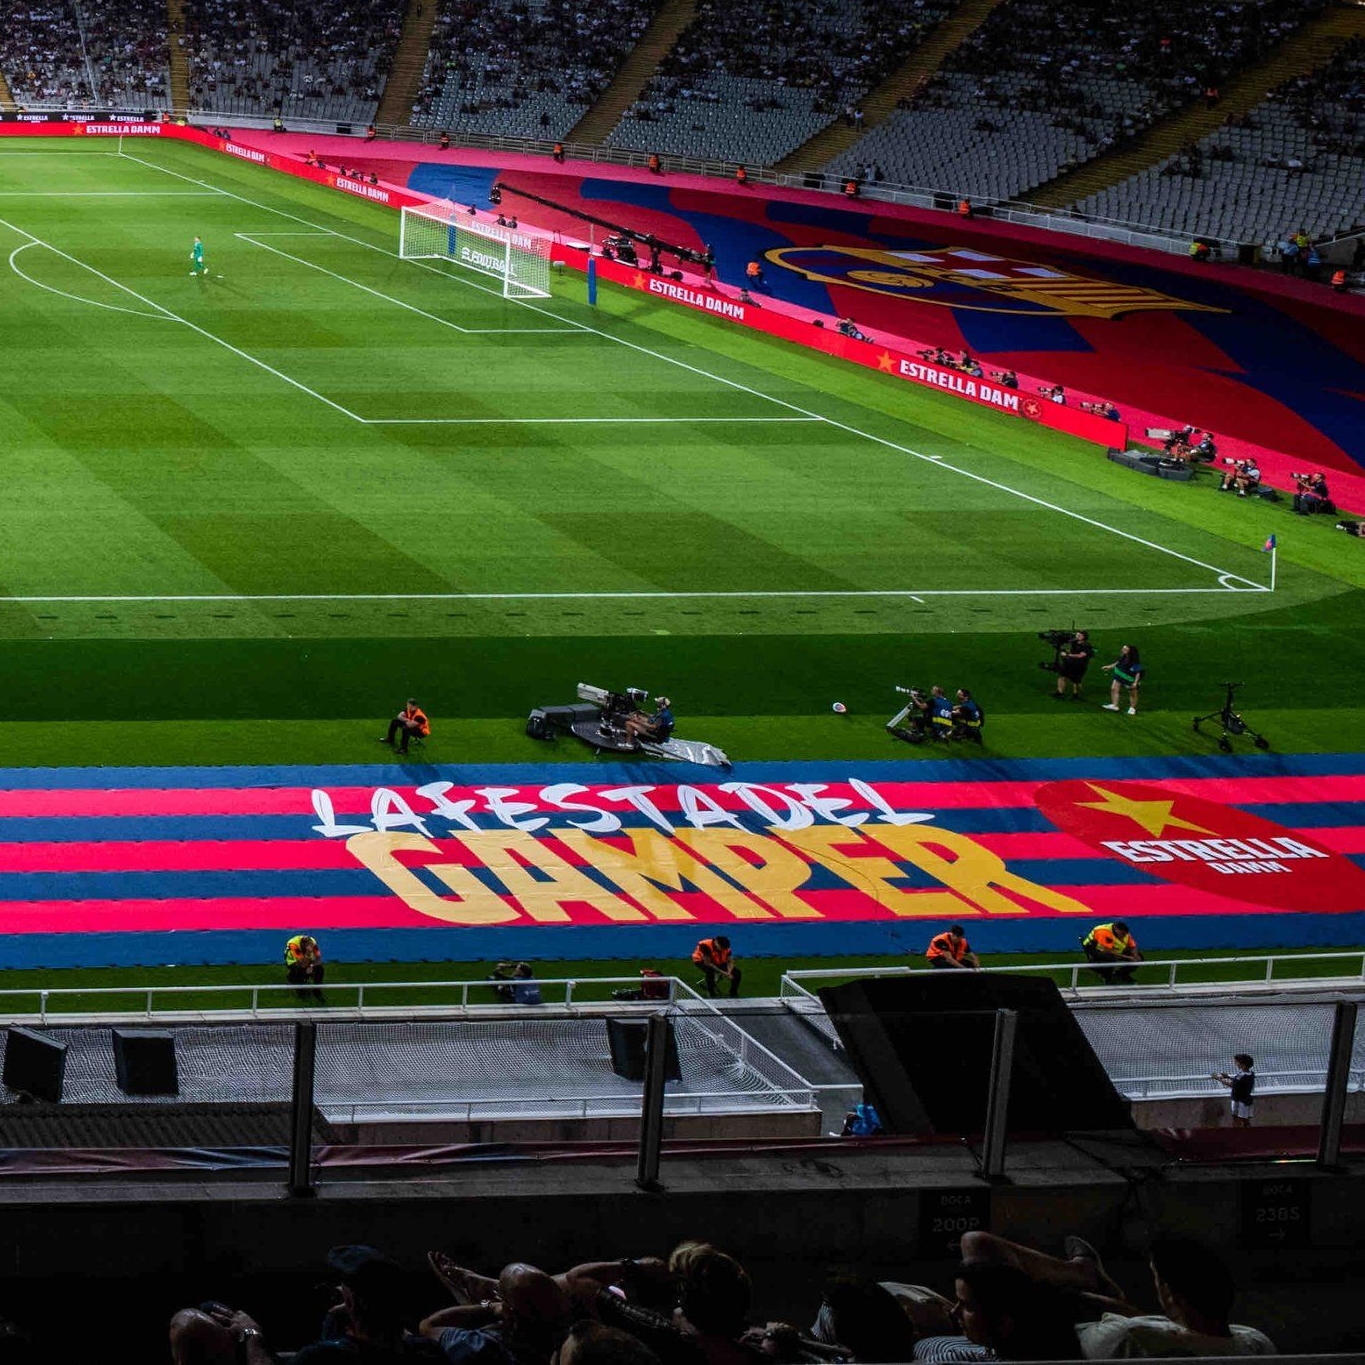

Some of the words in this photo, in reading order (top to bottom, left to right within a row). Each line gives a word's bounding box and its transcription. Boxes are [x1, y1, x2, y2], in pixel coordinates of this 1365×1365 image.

[86, 125, 129, 134] ESTRELLA
[131, 125, 160, 134] DAMM
[225, 142, 251, 159] ESTRELLA
[336, 177, 367, 197] ESTRELLA
[367, 186, 389, 203] DAMM
[649, 278, 704, 308] ESTRELLA
[705, 294, 745, 320] DAMM
[899, 358, 977, 397] ESTRELLA
[311, 787, 435, 838] LA
[415, 781, 748, 834] FESTA
[725, 778, 935, 832] DEL
[1100, 836, 1330, 863] ESTRELLA
[346, 822, 1093, 925] GAMPER
[1206, 860, 1293, 875] DAMM
[941, 1196, 972, 1206] BOCA
